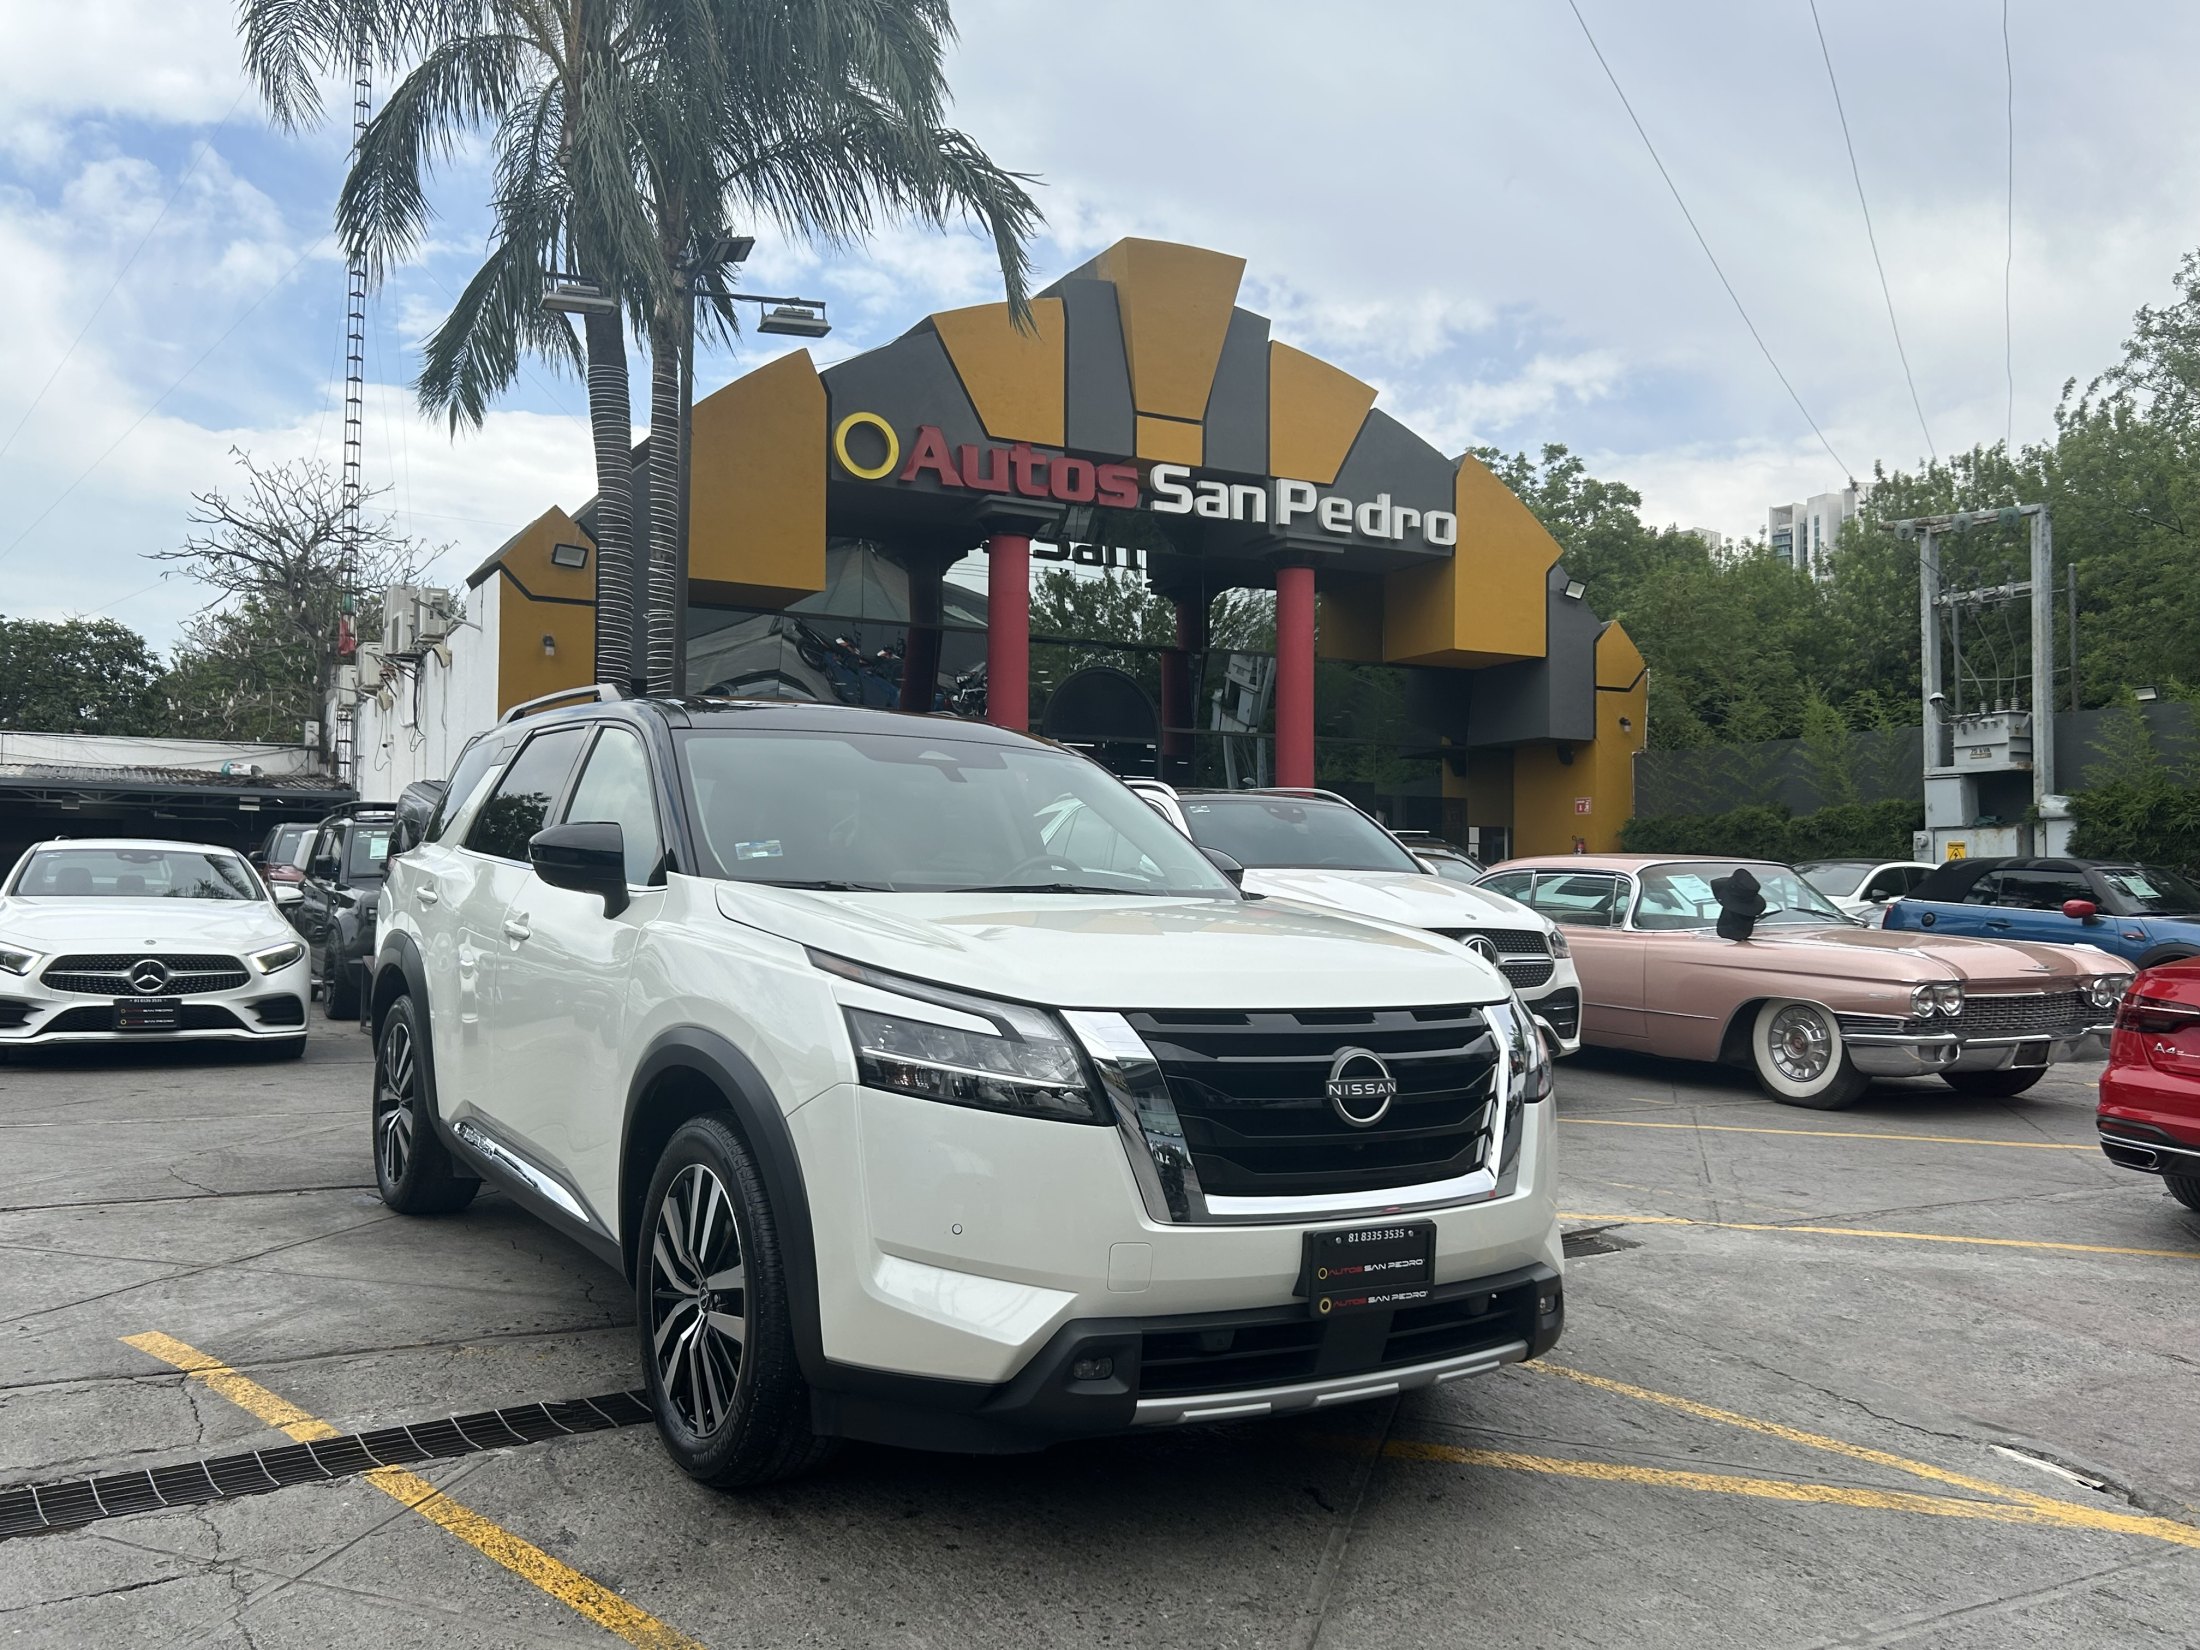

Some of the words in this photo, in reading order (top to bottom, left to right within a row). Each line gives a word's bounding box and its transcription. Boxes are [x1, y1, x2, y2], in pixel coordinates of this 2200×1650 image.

[900, 424, 1139, 509] Autos
[1328, 1082, 1397, 1096] NISSAN
[1348, 1233, 1359, 1242] 81
[1360, 1231, 1382, 1241] 8335
[1384, 1229, 1405, 1240] 3535
[1328, 1266, 1363, 1275] AUTOS
[1364, 1263, 1386, 1271] SAN
[1387, 1259, 1424, 1268] PEDRO
[1333, 1298, 1367, 1307] AUTOS
[1367, 1295, 1390, 1303] SAN
[1391, 1290, 1427, 1300] PEDRO
